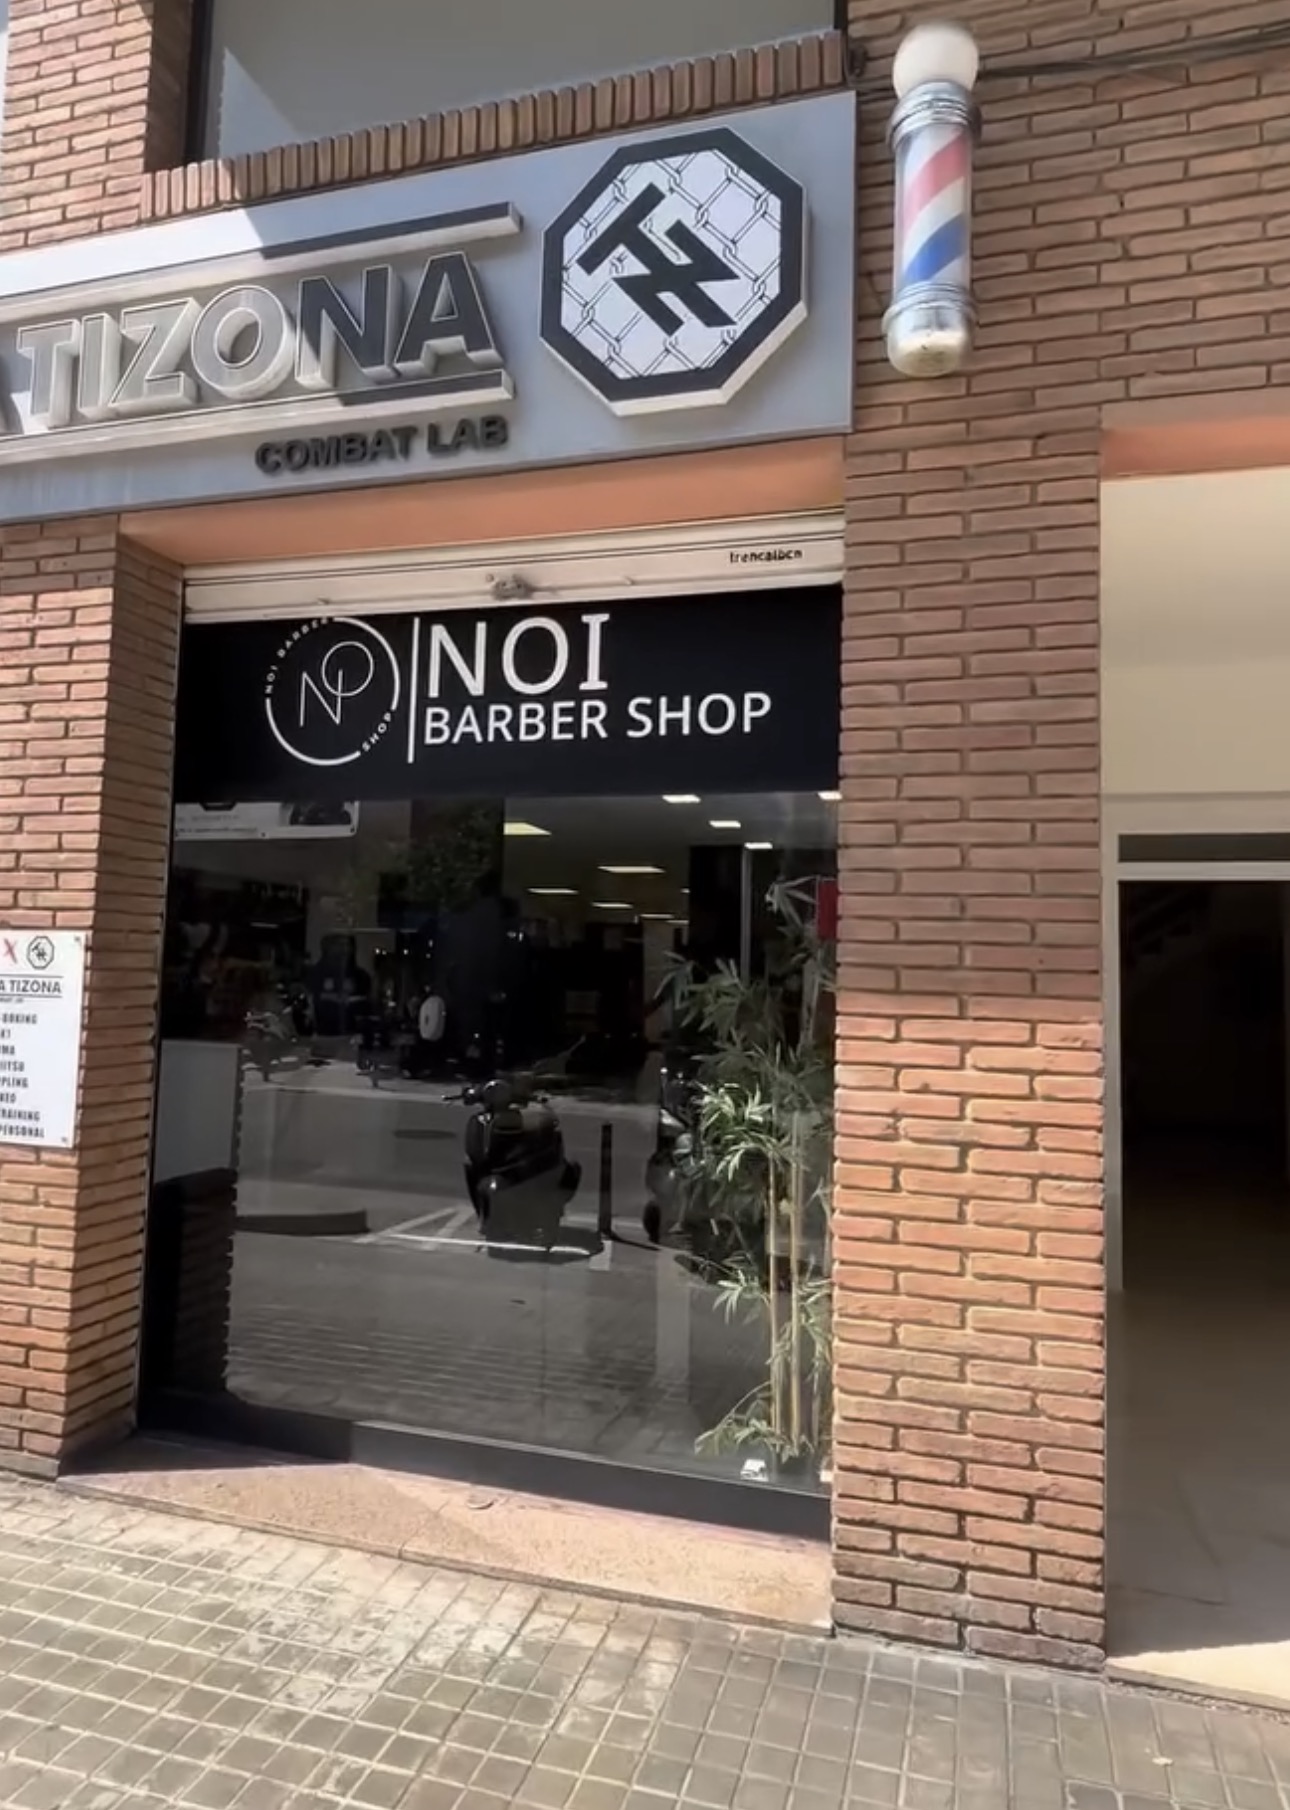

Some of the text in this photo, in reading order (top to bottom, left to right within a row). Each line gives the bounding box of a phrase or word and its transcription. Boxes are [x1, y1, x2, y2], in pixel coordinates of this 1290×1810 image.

[17, 251, 506, 429] TIZONA
[255, 414, 509, 476] COMBAT LAB
[428, 613, 610, 698] NOI
[361, 712, 392, 752] SHOP
[424, 692, 772, 745] BARBER SHOP
[10, 979, 62, 993] TIZONA
